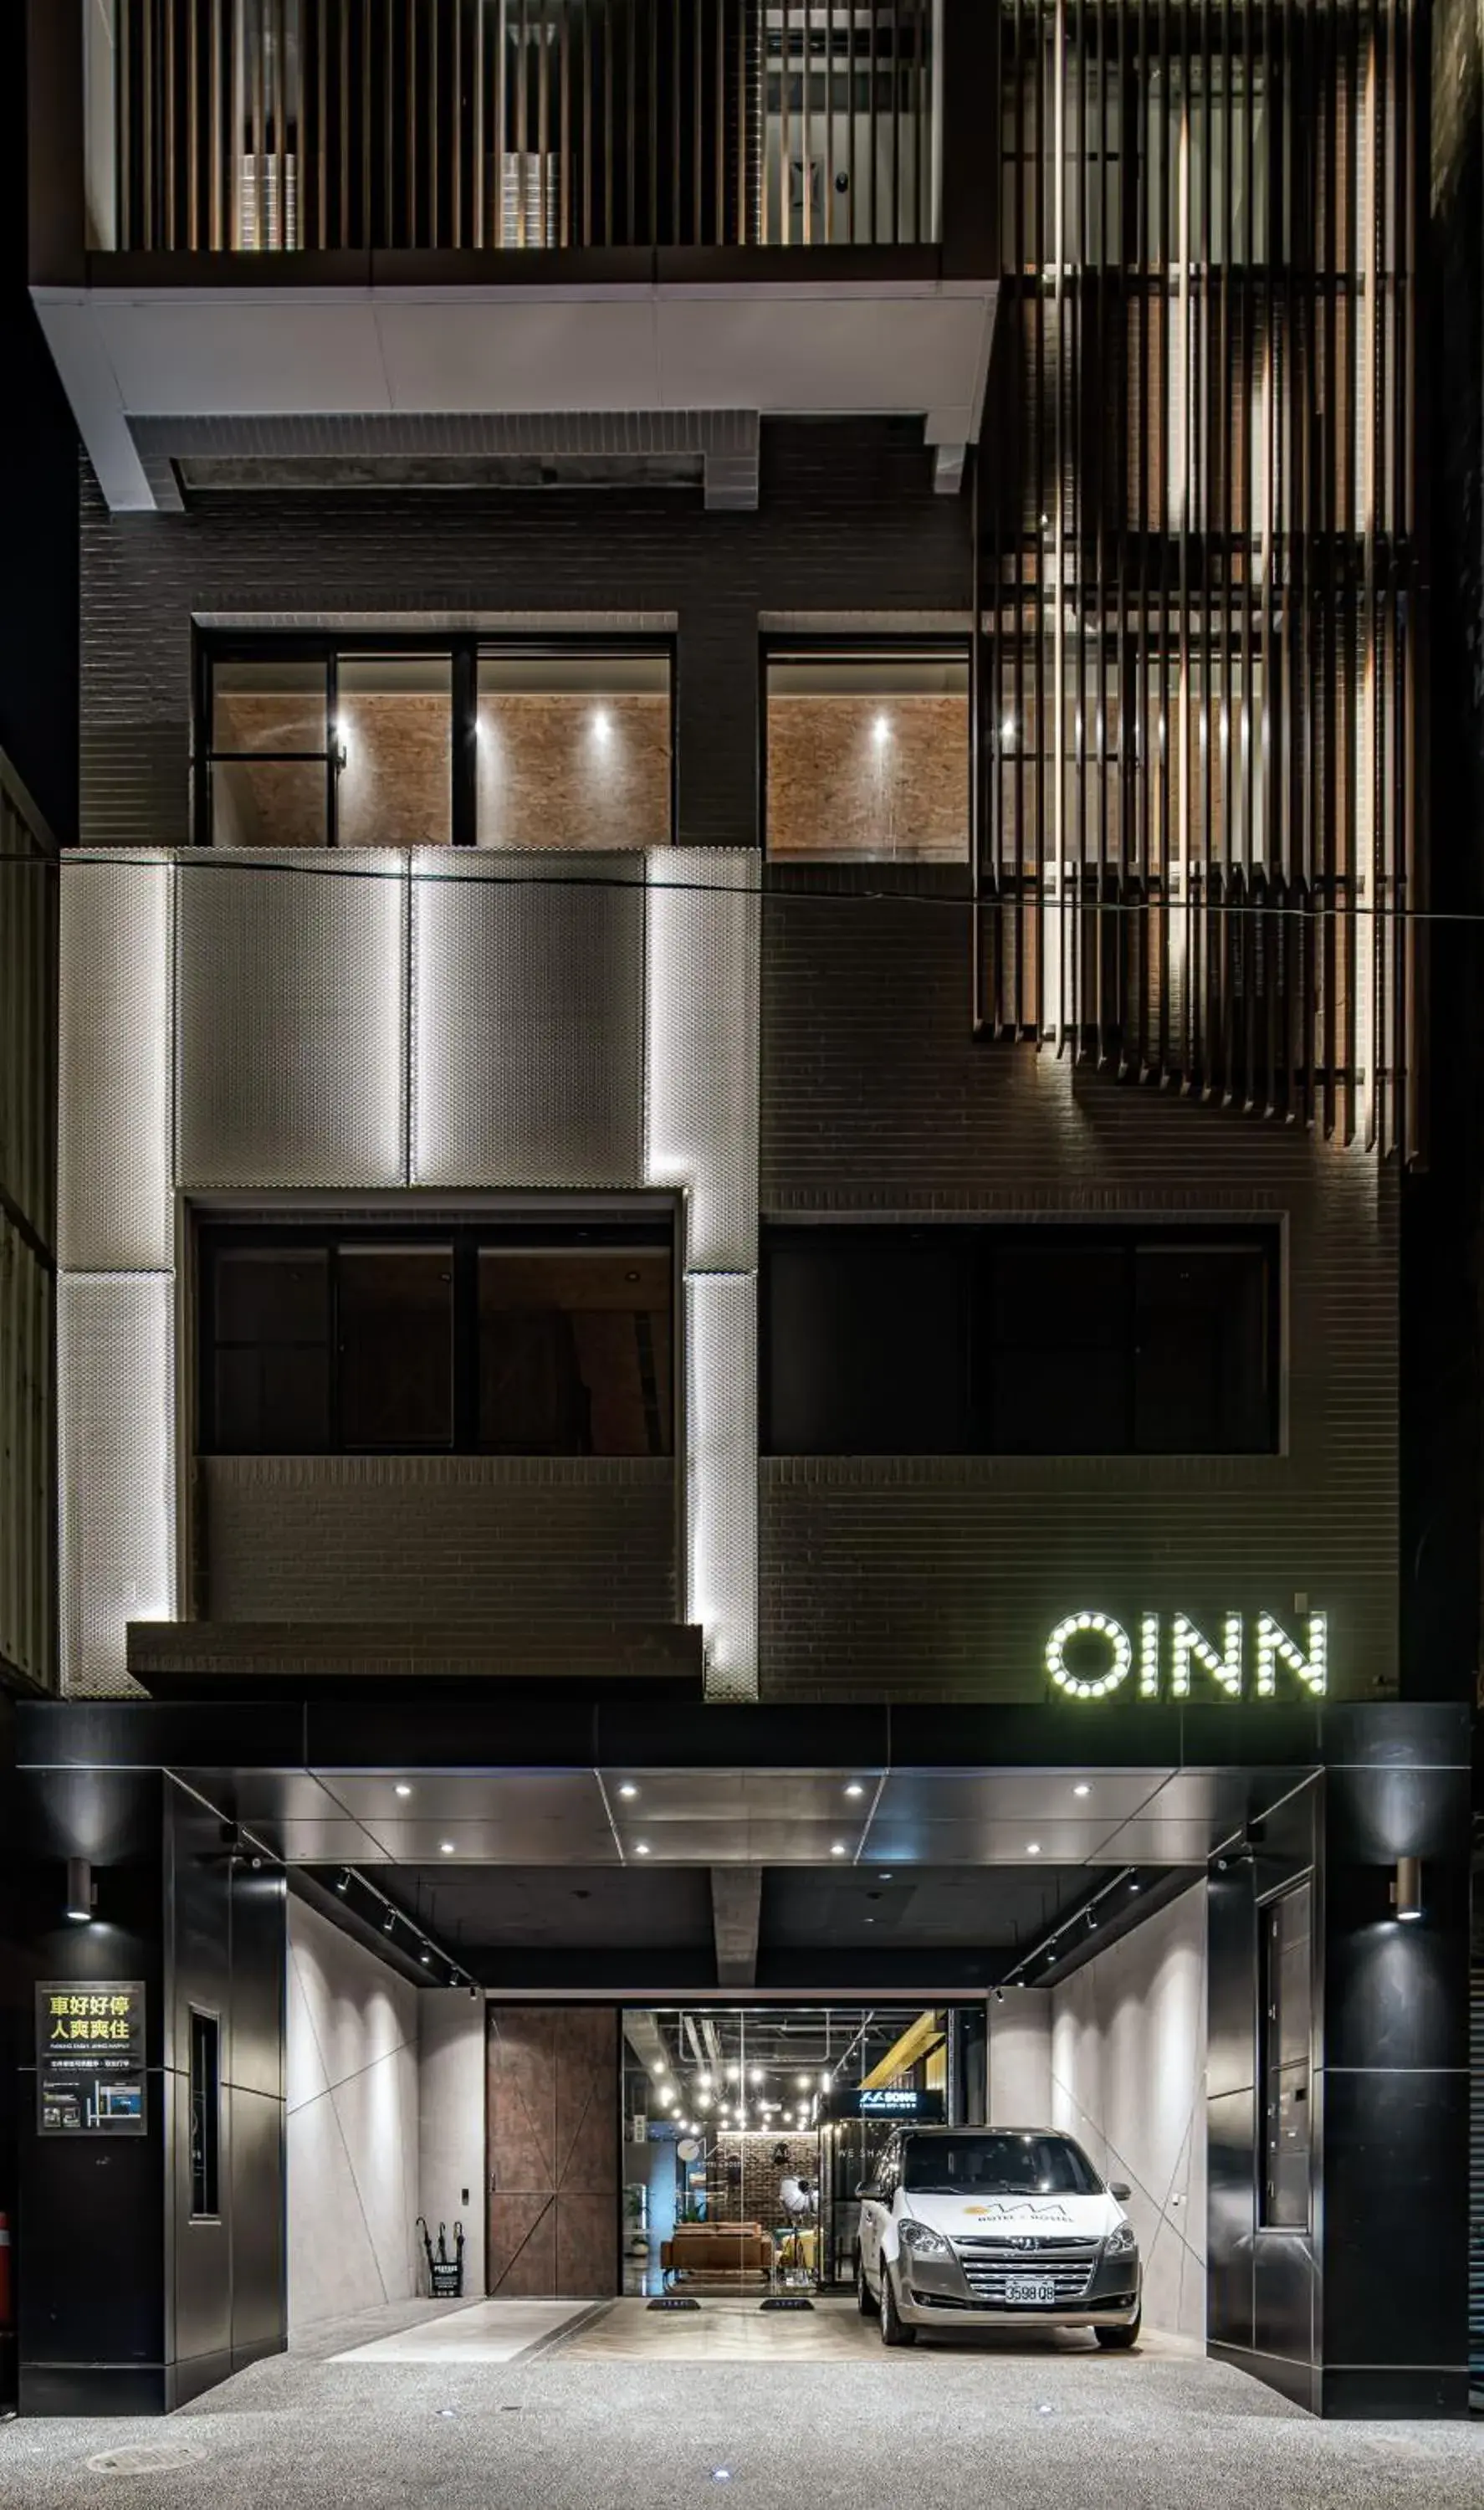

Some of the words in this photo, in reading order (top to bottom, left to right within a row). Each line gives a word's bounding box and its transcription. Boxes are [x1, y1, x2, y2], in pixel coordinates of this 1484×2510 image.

[1046, 1611, 1327, 1698] OINN
[50, 1996, 130, 2016] 車好好停
[50, 2020, 130, 2039] 人爽爽住
